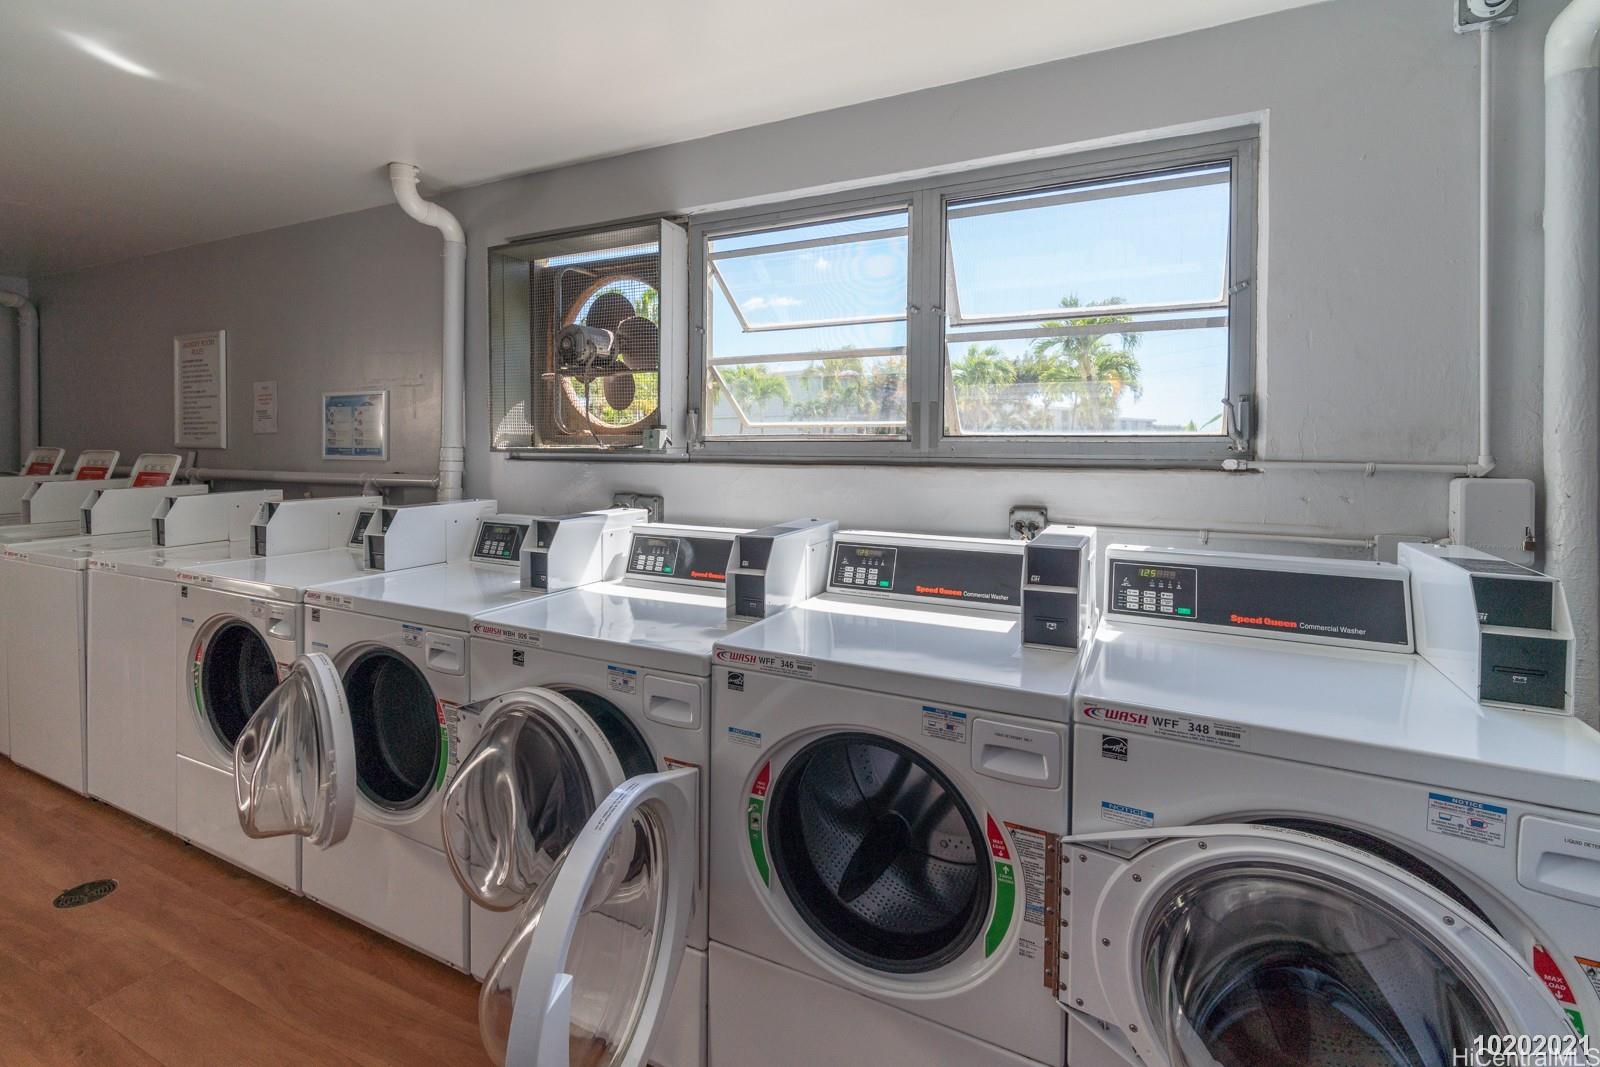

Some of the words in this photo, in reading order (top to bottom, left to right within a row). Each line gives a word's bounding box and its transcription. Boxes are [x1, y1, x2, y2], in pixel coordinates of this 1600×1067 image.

[963, 590, 991, 600] Commercial
[991, 592, 1009, 601] Washer
[1230, 614, 1263, 624] Speed
[1264, 617, 1297, 628] Queen
[1299, 622, 1339, 633] Commercial
[1340, 626, 1366, 635] Washer
[729, 652, 757, 664] WASH
[759, 656, 776, 666] WFF
[780, 660, 794, 669] 346
[1105, 709, 1148, 725] WASH
[1152, 716, 1179, 728] WFF
[1188, 722, 1210, 735] 348
[1109, 803, 1148, 817] NOTICE
[1452, 798, 1484, 809] NOTICE
[1544, 974, 1563, 984] MAX
